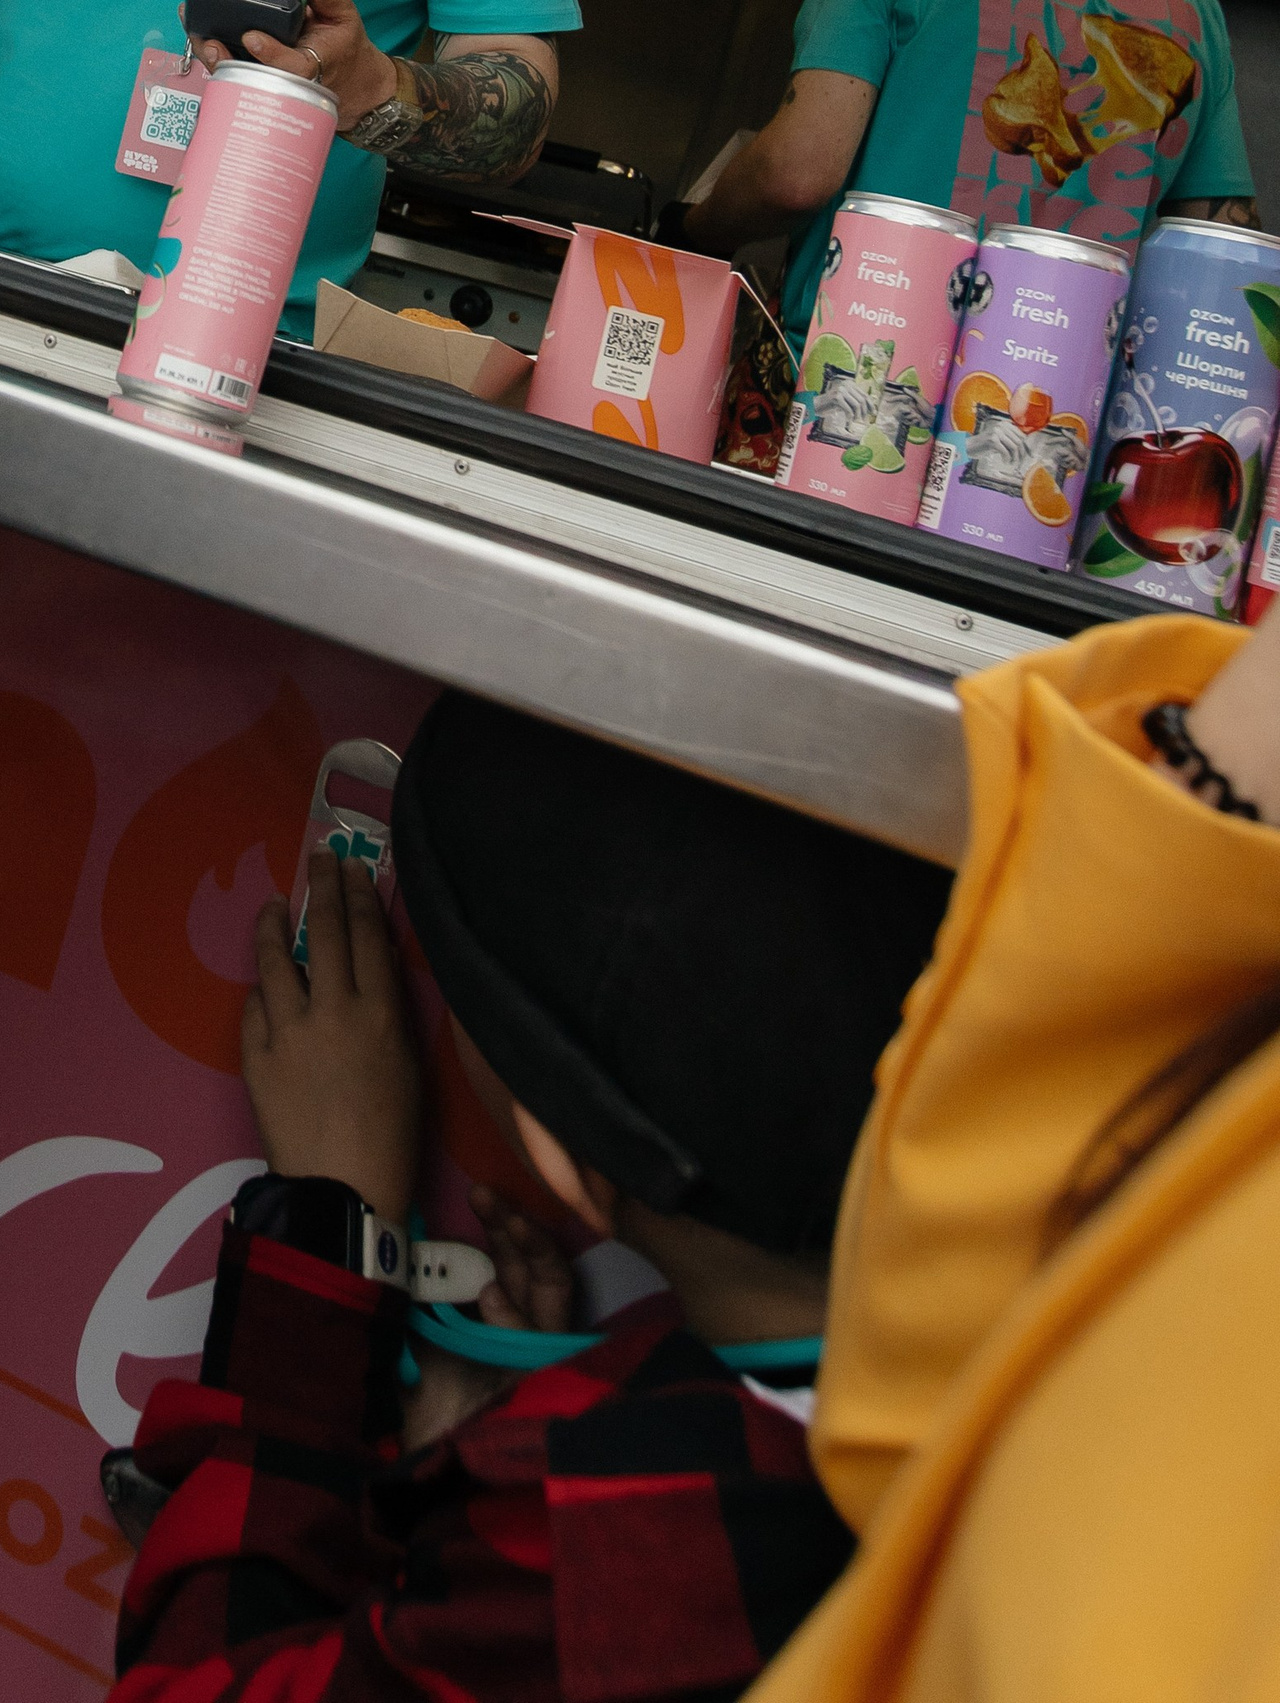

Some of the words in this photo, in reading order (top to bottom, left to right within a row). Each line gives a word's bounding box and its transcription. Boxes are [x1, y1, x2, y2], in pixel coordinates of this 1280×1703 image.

[856, 262, 911, 290] fresh
[847, 301, 907, 328] Mojito
[1011, 298, 1069, 329] fresh
[1185, 320, 1250, 355] fresh
[1002, 339, 1059, 367] Spritz
[1176, 351, 1246, 382] Шорли
[1164, 370, 1249, 400] черешня
[808, 479, 828, 492] 330
[962, 522, 984, 537] 330
[1133, 579, 1167, 598] 450
